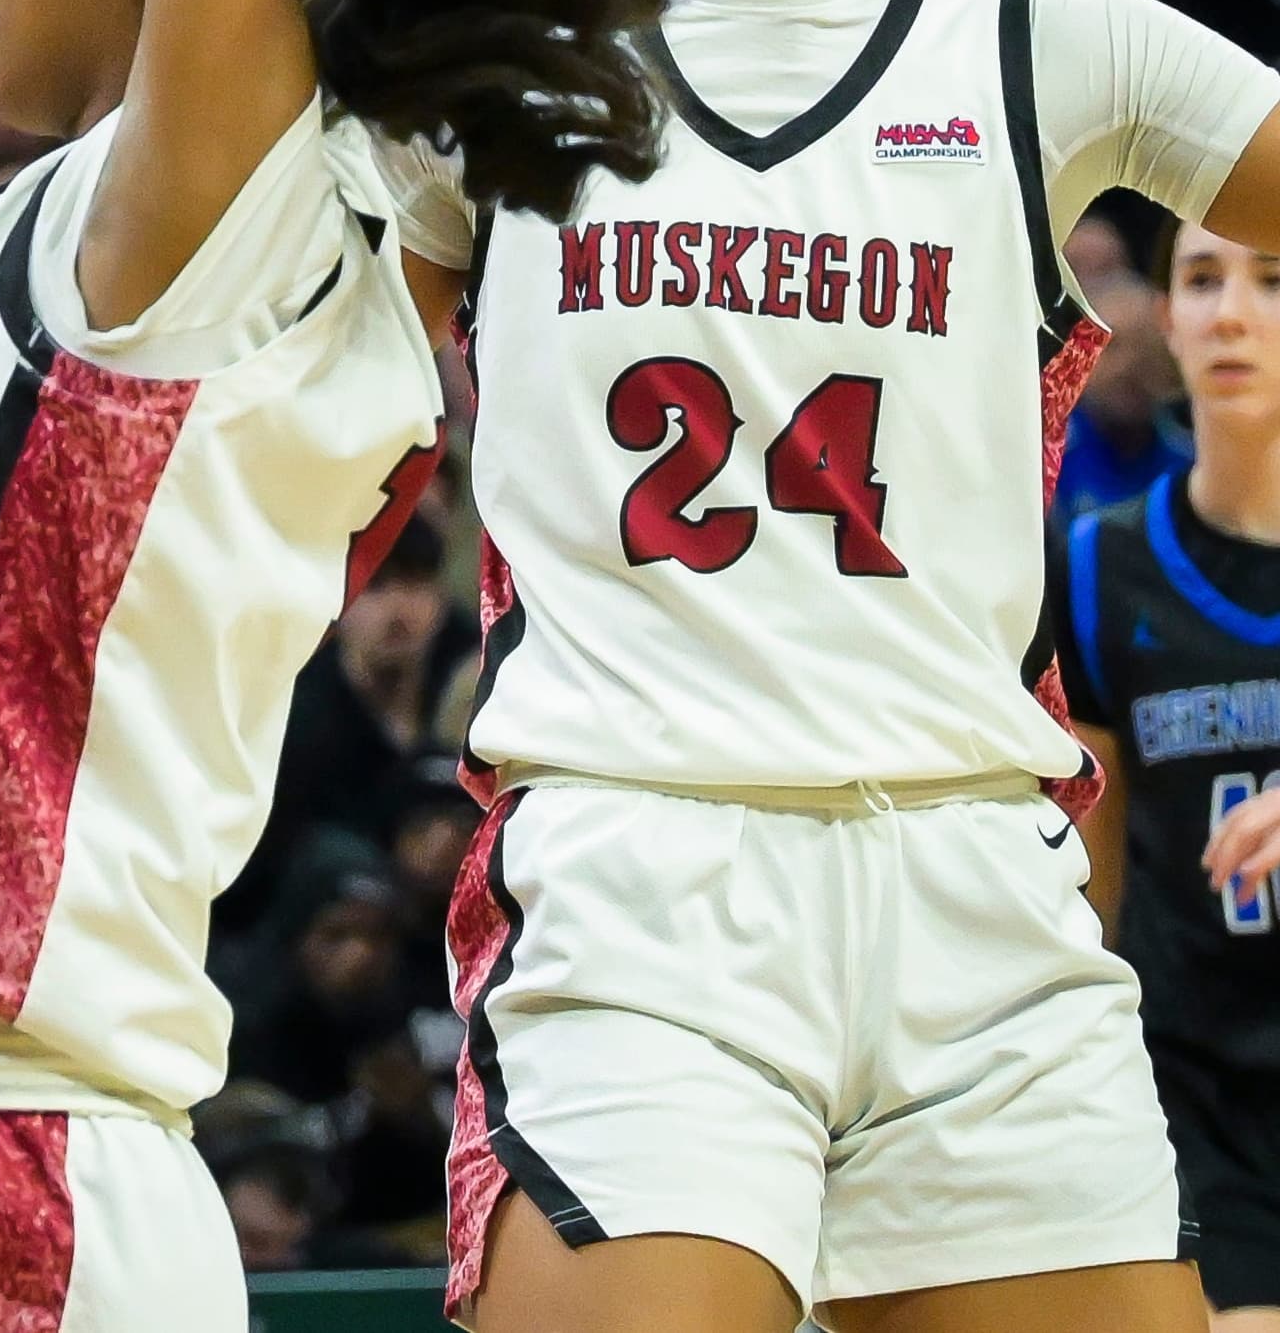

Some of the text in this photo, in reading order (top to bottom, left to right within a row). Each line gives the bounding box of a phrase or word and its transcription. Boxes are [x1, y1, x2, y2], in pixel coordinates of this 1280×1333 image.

[875, 117, 980, 147] MHSAA
[875, 148, 982, 159] CHAMPIONSHIPS
[558, 220, 954, 338] MUSKEGON
[605, 355, 910, 579] 24
